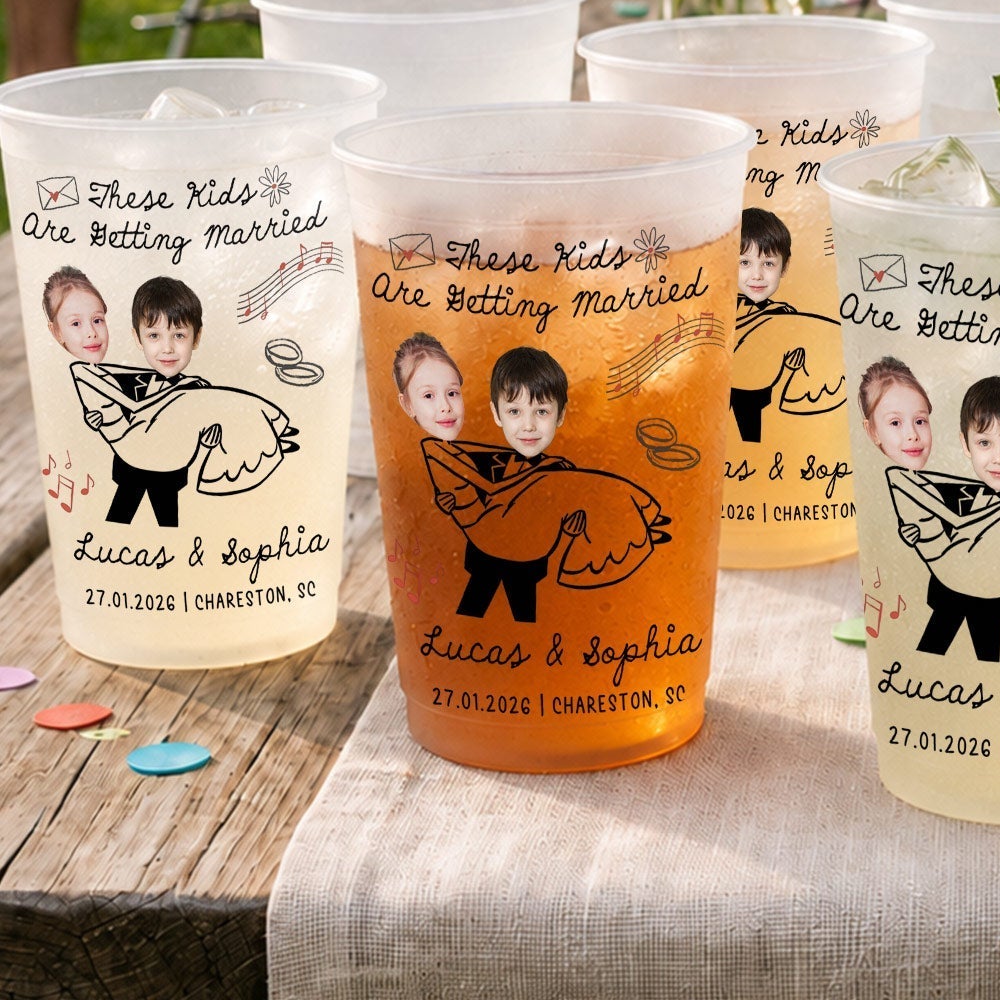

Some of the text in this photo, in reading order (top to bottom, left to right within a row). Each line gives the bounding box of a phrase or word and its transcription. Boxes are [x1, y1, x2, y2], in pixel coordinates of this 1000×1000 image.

[781, 118, 848, 147] Kids
[88, 178, 258, 211] These Kids
[22, 200, 328, 265] Are Getting Married
[445, 238, 632, 274] These Kids
[372, 266, 709, 334] Are Getting Married
[839, 292, 901, 332] Are
[768, 451, 784, 481] &
[800, 454, 853, 499] Sop
[74, 525, 330, 584] Lucas & Sophia
[85, 588, 175, 612] 27.01.2026
[194, 584, 291, 612] CHARESTON,
[298, 580, 316, 599] SC
[420, 623, 703, 688] Lucas & Sophia
[432, 687, 531, 716] 27.01.2026
[552, 689, 660, 716] CHARESTON,
[665, 684, 686, 706] SC
[877, 660, 994, 710] Lucas
[889, 725, 991, 759] 27.01.2026
